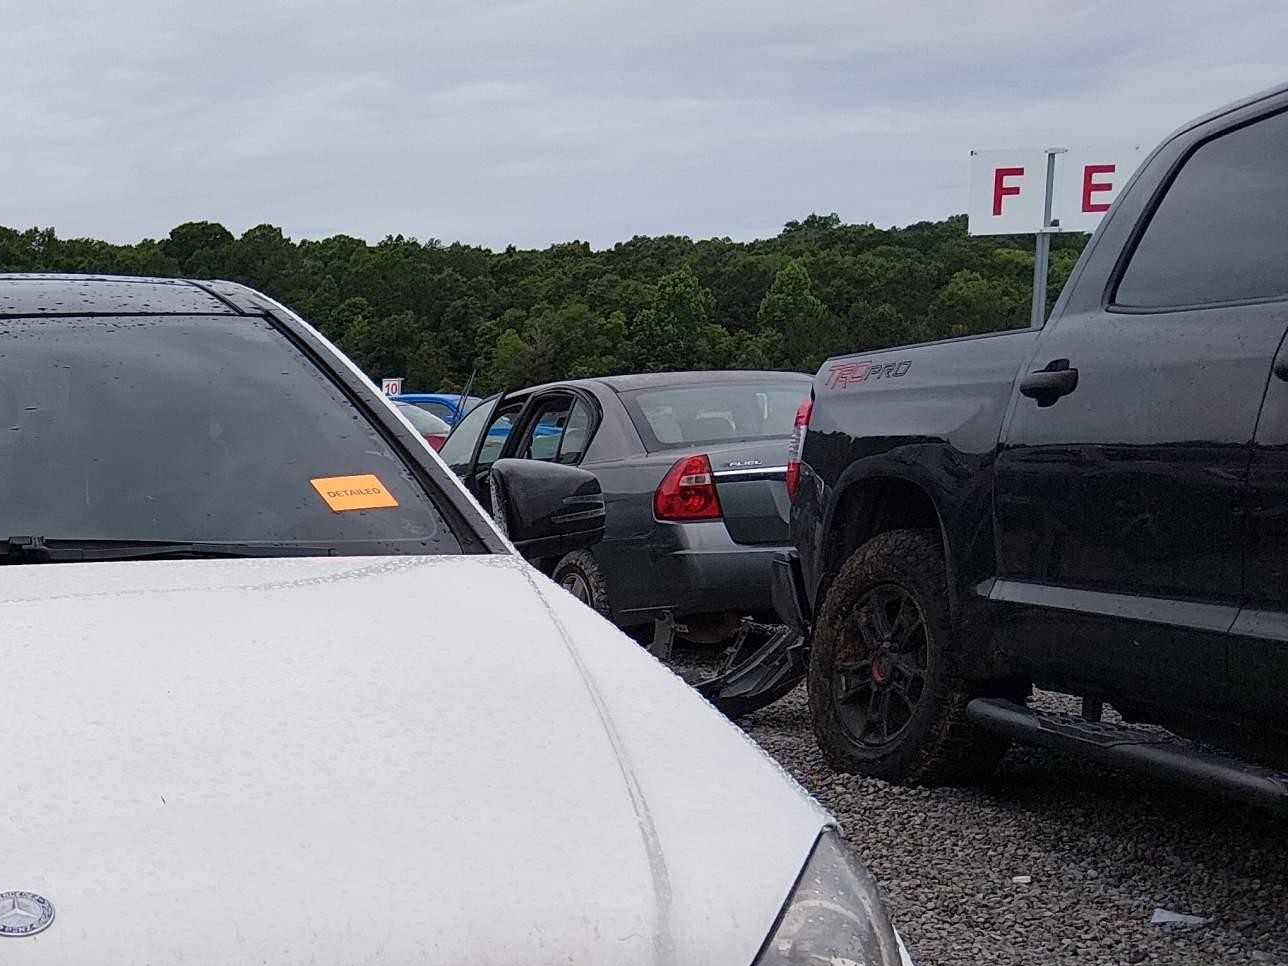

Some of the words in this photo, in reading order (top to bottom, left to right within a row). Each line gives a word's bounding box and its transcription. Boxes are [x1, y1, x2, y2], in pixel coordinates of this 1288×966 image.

[993, 167, 1024, 215] F
[1081, 164, 1116, 213] E
[384, 383, 398, 395] 10
[327, 487, 381, 498] DETAILED
